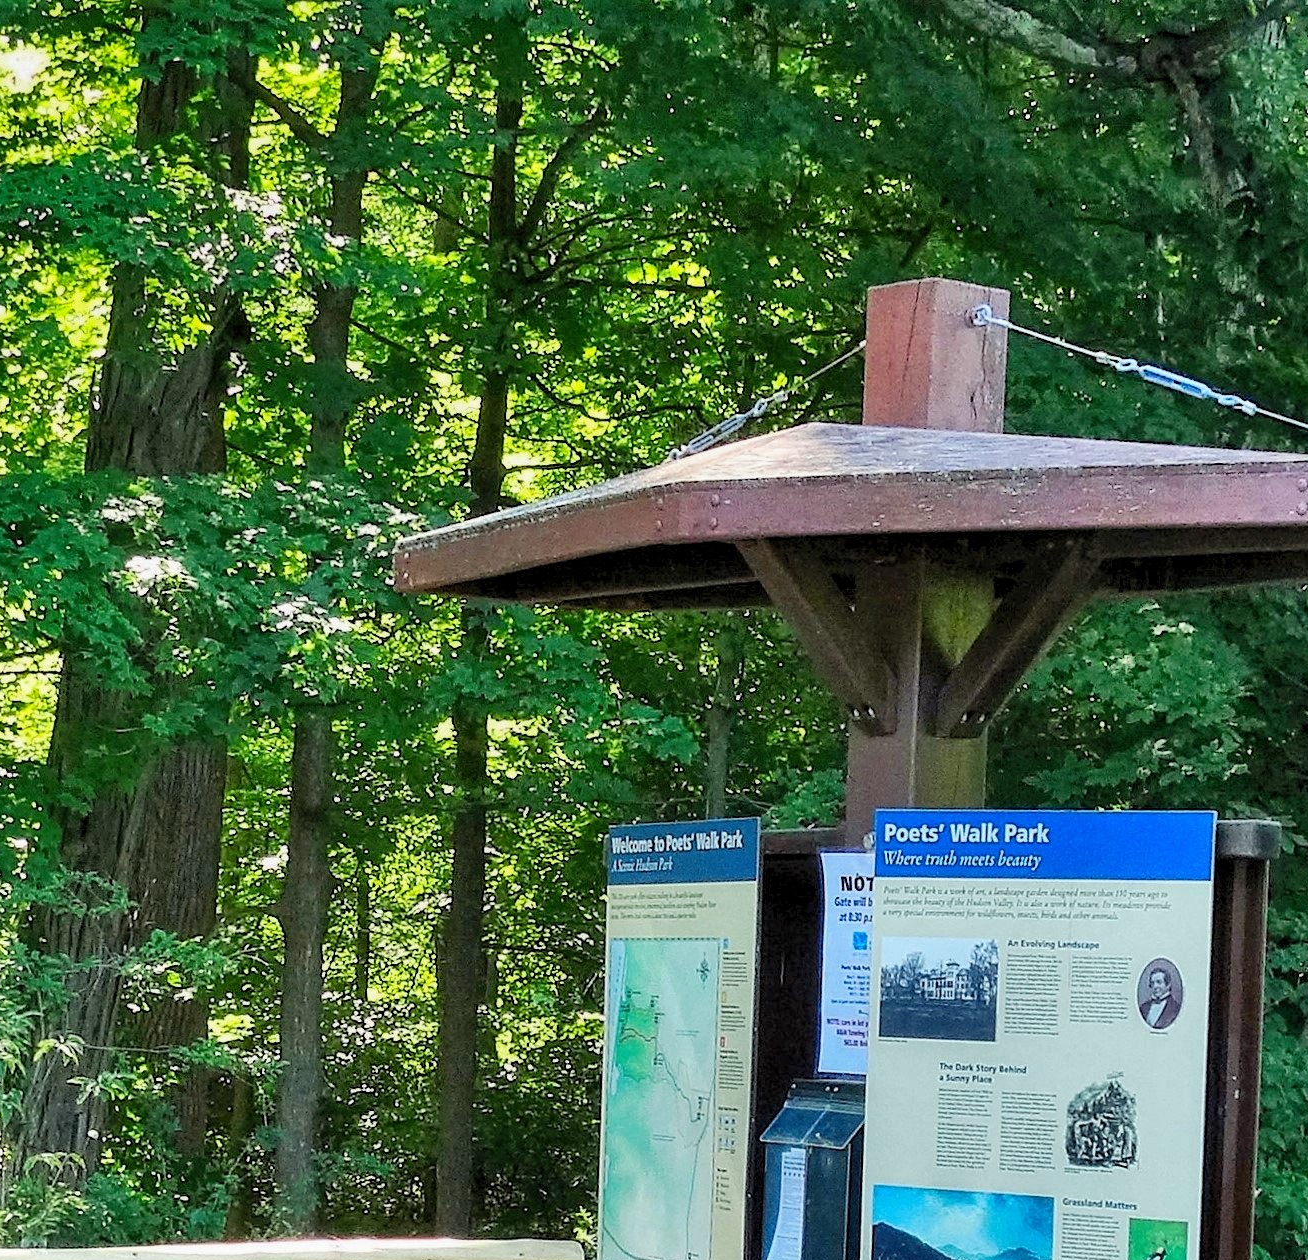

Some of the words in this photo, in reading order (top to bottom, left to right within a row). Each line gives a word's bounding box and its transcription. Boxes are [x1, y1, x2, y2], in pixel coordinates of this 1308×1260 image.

[884, 823, 945, 843] Poets'
[950, 822, 999, 843] Walk
[1004, 822, 1050, 843] Park
[612, 836, 653, 854] Welcome
[654, 835, 665, 852] to
[665, 833, 695, 852] Poets'
[696, 831, 720, 850] Walk
[720, 829, 743, 849] Park
[658, 856, 674, 871] Park
[883, 849, 923, 866] Where
[925, 850, 957, 867] truth
[959, 854, 995, 867] meets
[997, 850, 1042, 871] beauty
[921, 886, 936, 895] Park
[949, 886, 966, 896] work
[967, 886, 975, 897] of
[994, 887, 1024, 898] landscape
[1025, 888, 1048, 898] garden
[1050, 888, 1079, 899] designed
[1097, 888, 1113, 898] than
[1127, 890, 1145, 900] years
[1147, 891, 1160, 900] ago
[834, 897, 851, 907] Gate
[853, 897, 866, 907] will
[924, 897, 945, 908] beauty
[946, 898, 955, 908] of
[839, 913, 847, 922] at
[1058, 911, 1072, 919] and
[1007, 939, 1019, 947] An
[1020, 940, 1056, 950] Evolving
[1057, 941, 1100, 951] Landscape
[940, 1062, 954, 1071] The
[955, 1063, 973, 1072] Dark
[976, 1064, 997, 1075] Story
[999, 1065, 1027, 1074] Behind
[946, 1074, 970, 1084] Sunny
[972, 1075, 993, 1084] Place
[1062, 1197, 1103, 1208] Grassland
[1105, 1201, 1138, 1211] Matters
